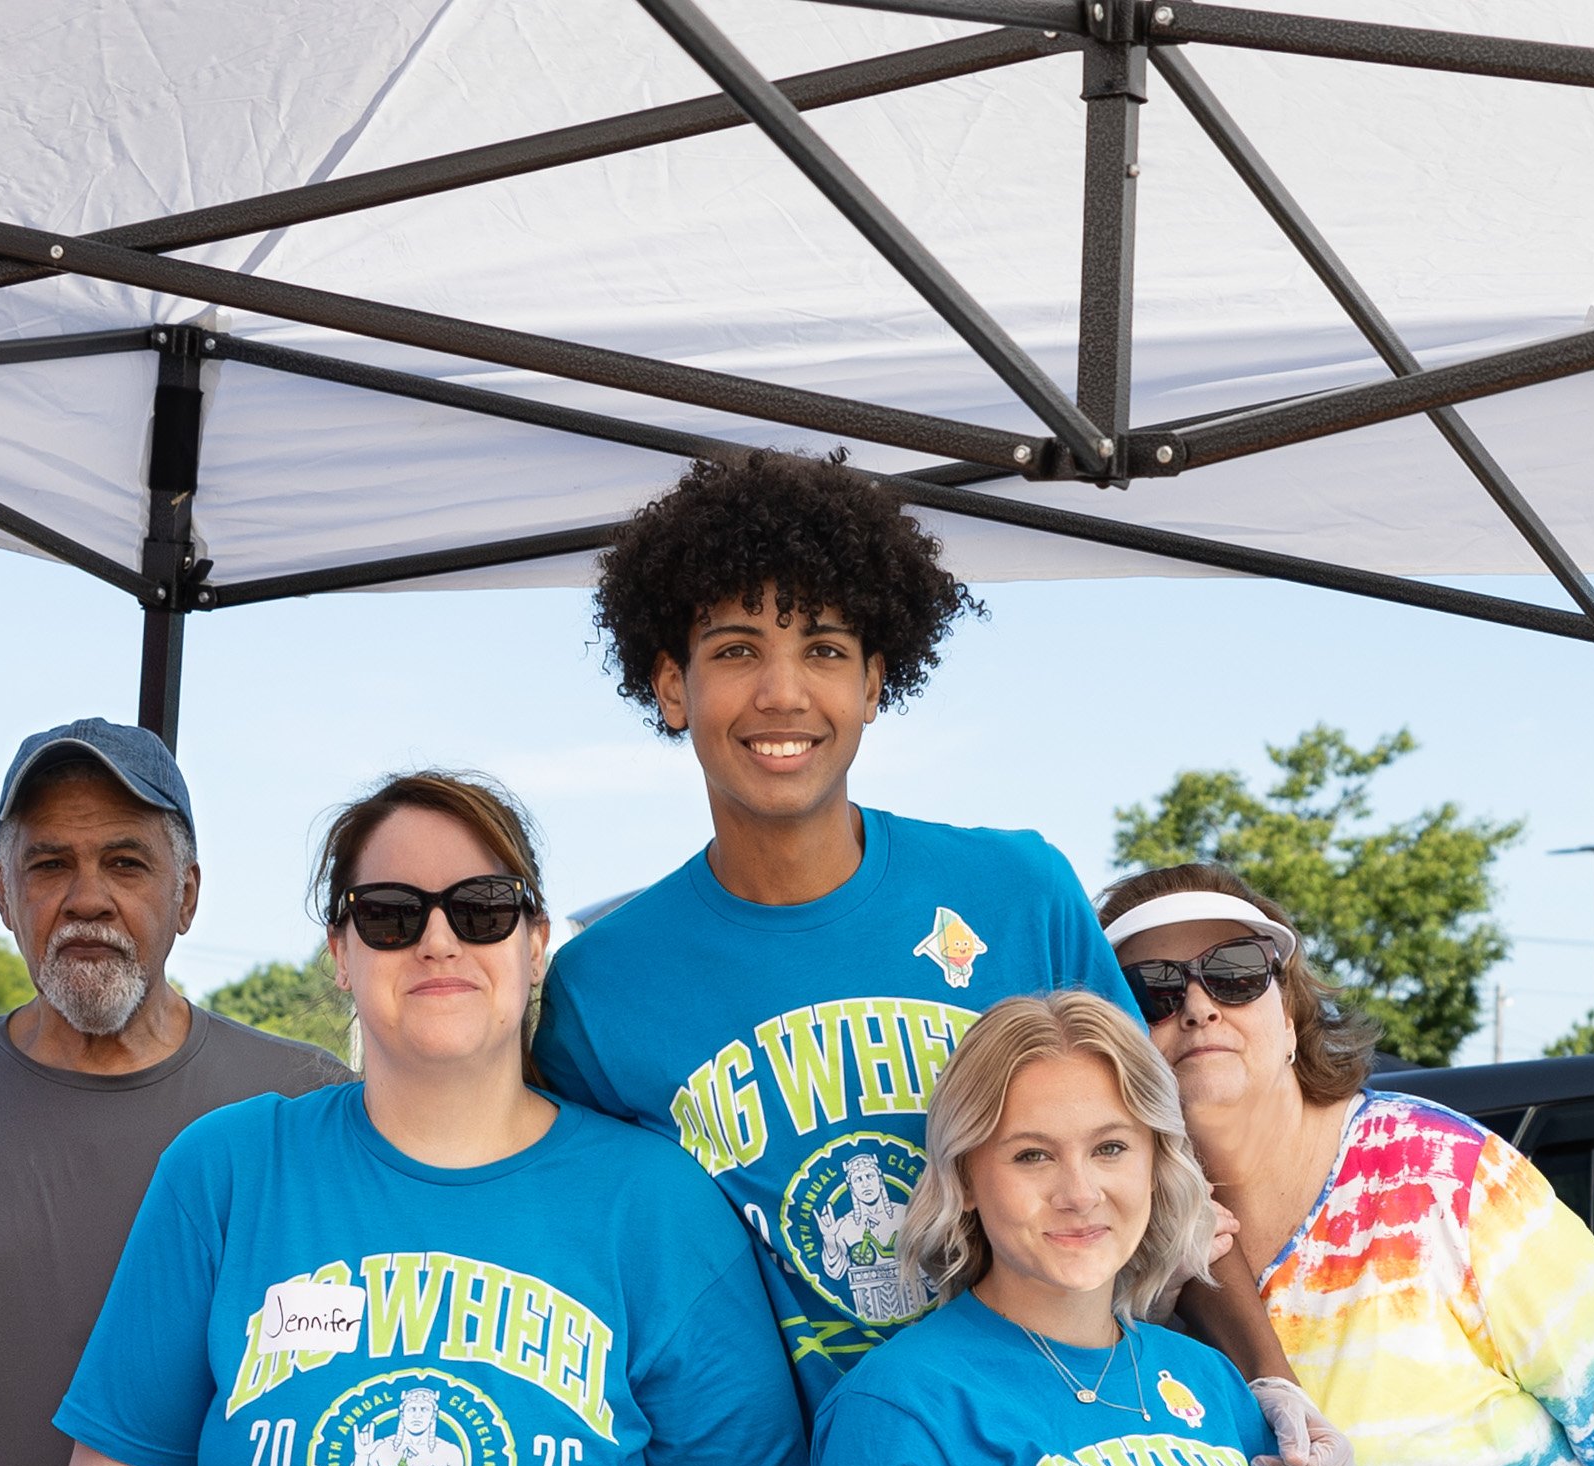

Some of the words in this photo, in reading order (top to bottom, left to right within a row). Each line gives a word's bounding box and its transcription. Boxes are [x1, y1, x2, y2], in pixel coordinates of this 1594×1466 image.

[753, 996, 984, 1136] WHE
[800, 1167, 837, 1220] ANNUAL
[265, 1295, 362, 1338] Jennifer
[360, 1251, 619, 1445] WHEEL
[338, 1392, 393, 1435] ANNUAL
